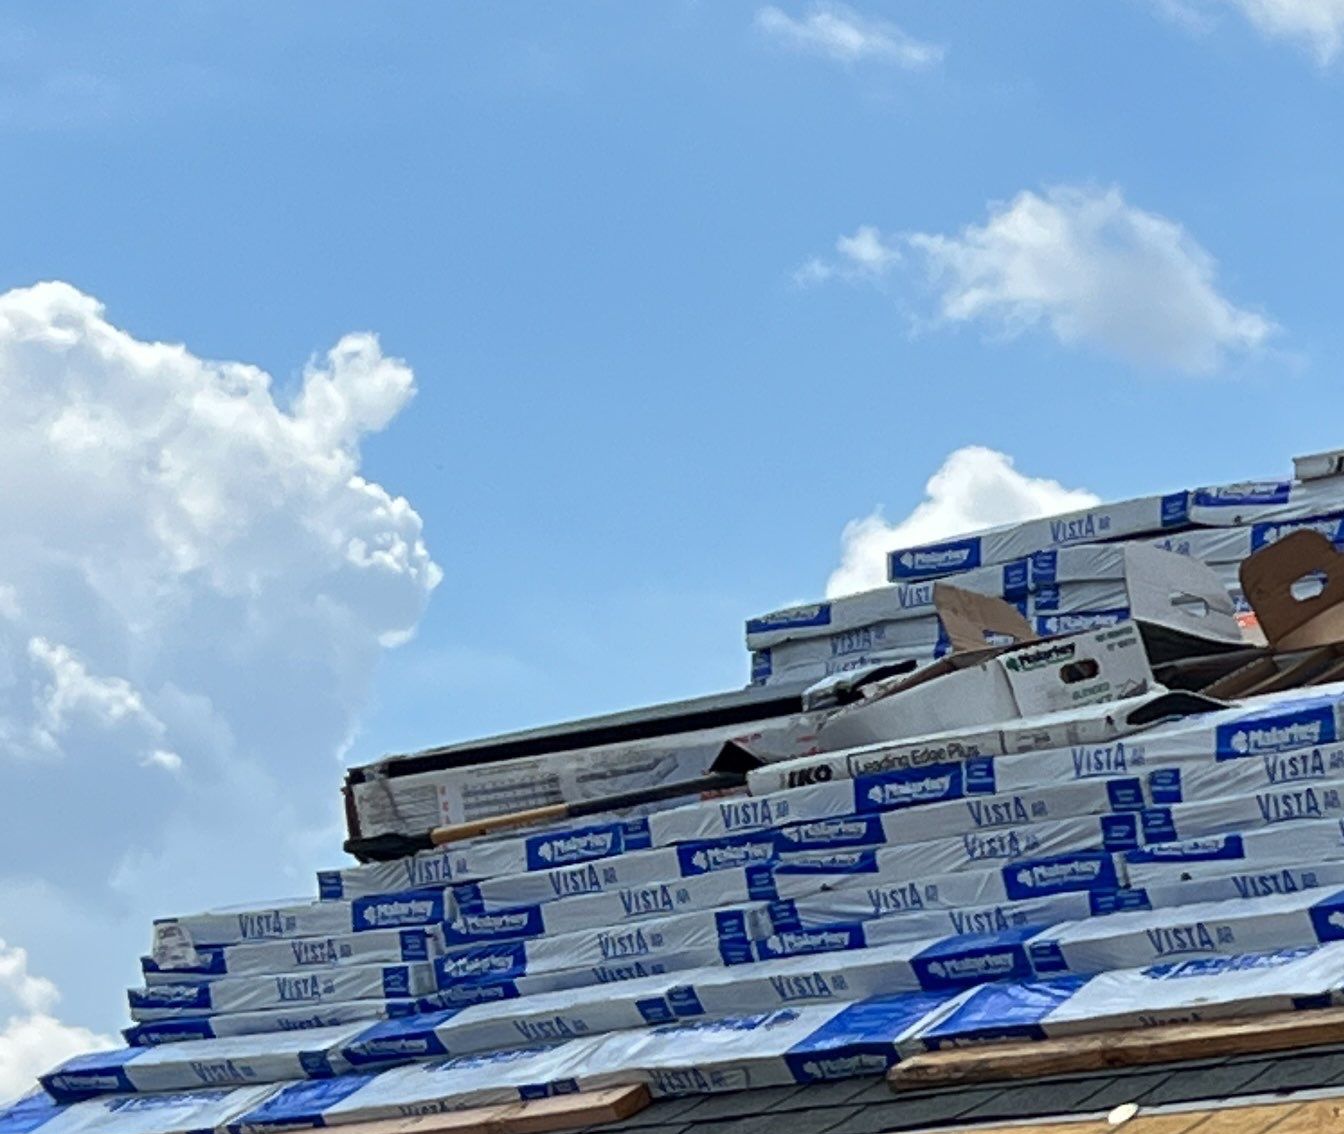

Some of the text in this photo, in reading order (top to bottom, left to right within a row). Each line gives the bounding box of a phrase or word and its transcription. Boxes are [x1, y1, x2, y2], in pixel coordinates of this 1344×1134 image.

[1072, 743, 1128, 777] VISTA
[1266, 750, 1326, 783] VISTA
[1256, 788, 1322, 822] VISTA
[1147, 923, 1217, 953] VISTA
